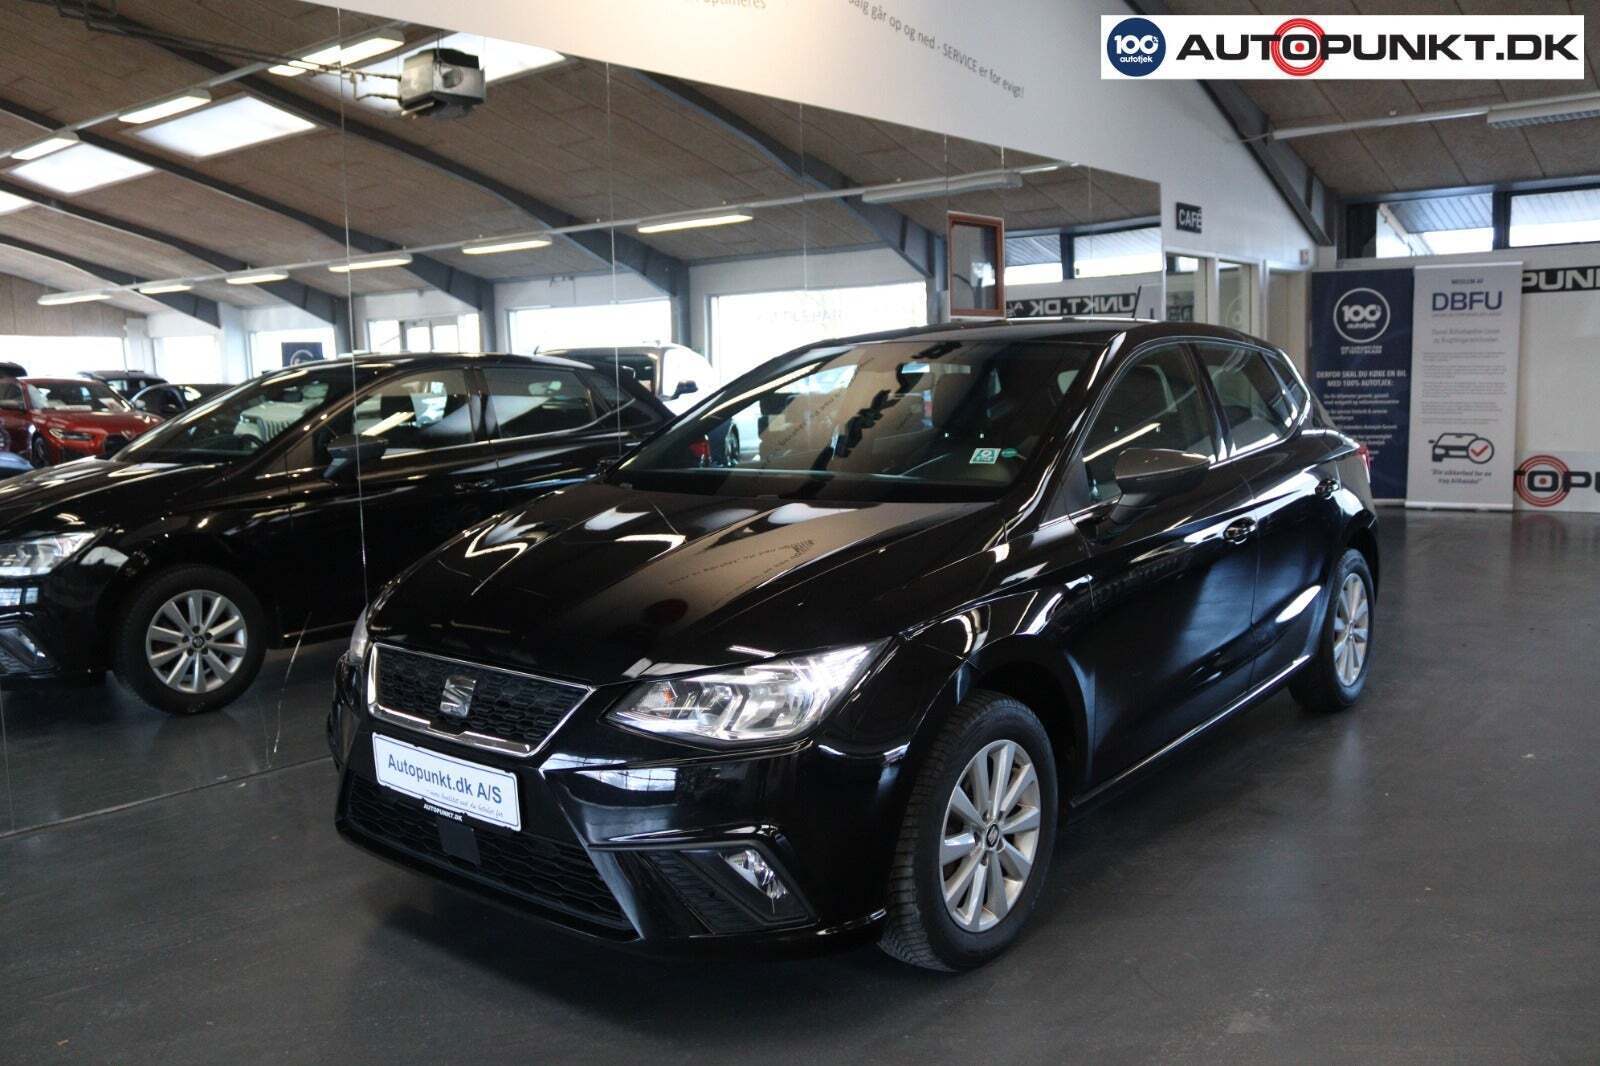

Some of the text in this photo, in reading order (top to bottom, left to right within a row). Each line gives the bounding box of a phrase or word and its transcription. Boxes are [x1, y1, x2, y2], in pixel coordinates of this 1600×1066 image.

[871, 4, 887, 21] går
[889, 16, 902, 31] op
[904, 25, 916, 42] og
[918, 31, 936, 49] ned
[943, 44, 977, 73] SERVICE
[979, 65, 988, 78] er
[990, 69, 1001, 85] for
[1002, 78, 1025, 98] evig!
[1521, 268, 1600, 290] PUN
[1432, 291, 1503, 311] DBFU
[388, 754, 474, 797] Autopunkt.dk
[477, 782, 503, 804] A/S
[423, 803, 463, 822] AUTOPUNKT.DK
